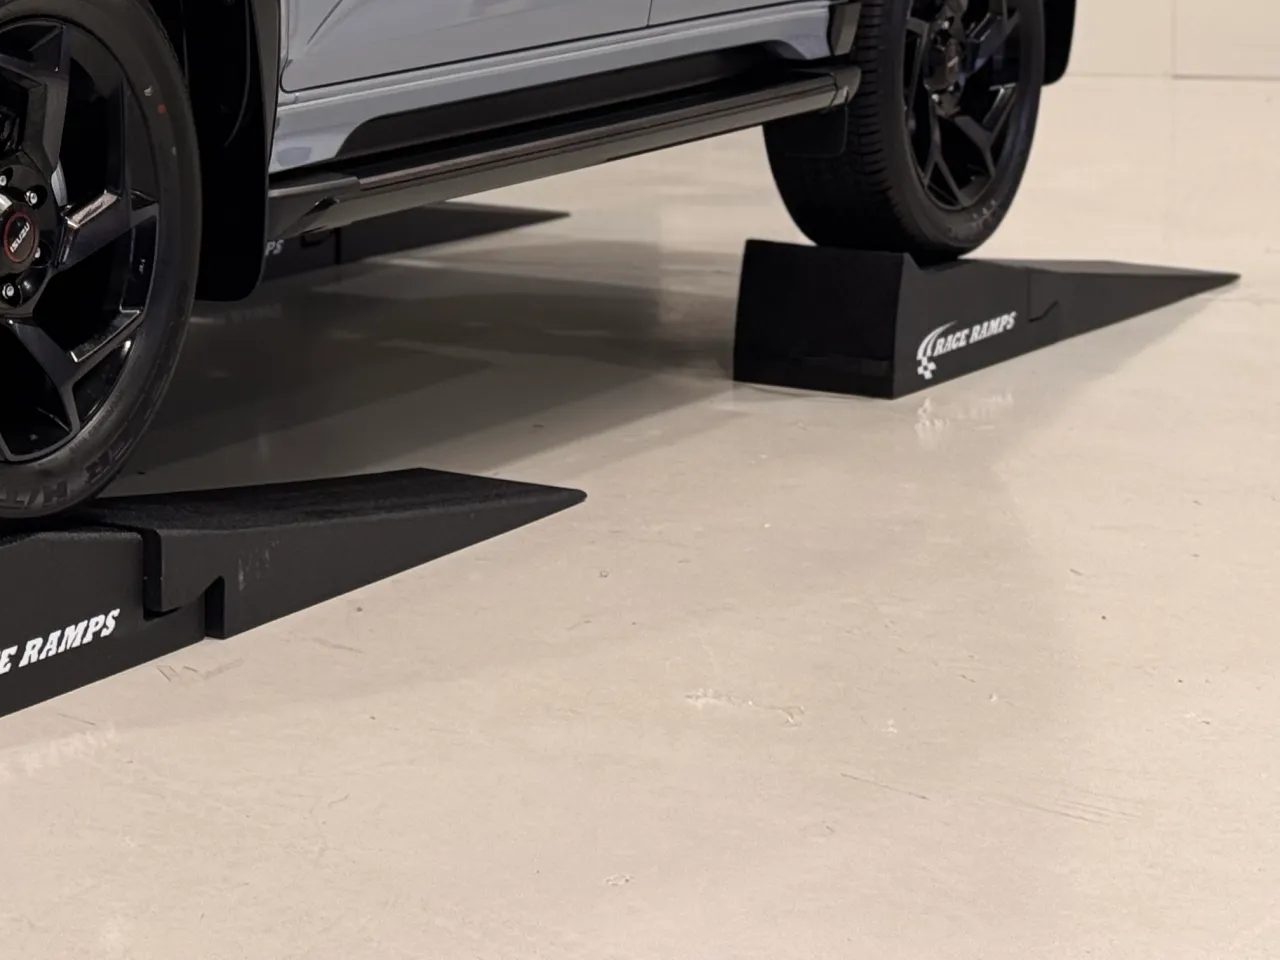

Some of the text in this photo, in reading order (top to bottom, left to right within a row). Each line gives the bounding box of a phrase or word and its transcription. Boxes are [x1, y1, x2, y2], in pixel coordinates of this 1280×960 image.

[9, 221, 31, 254] ISUZU
[933, 310, 1019, 358] RACE RAMPS
[18, 607, 121, 669] RAMPS
